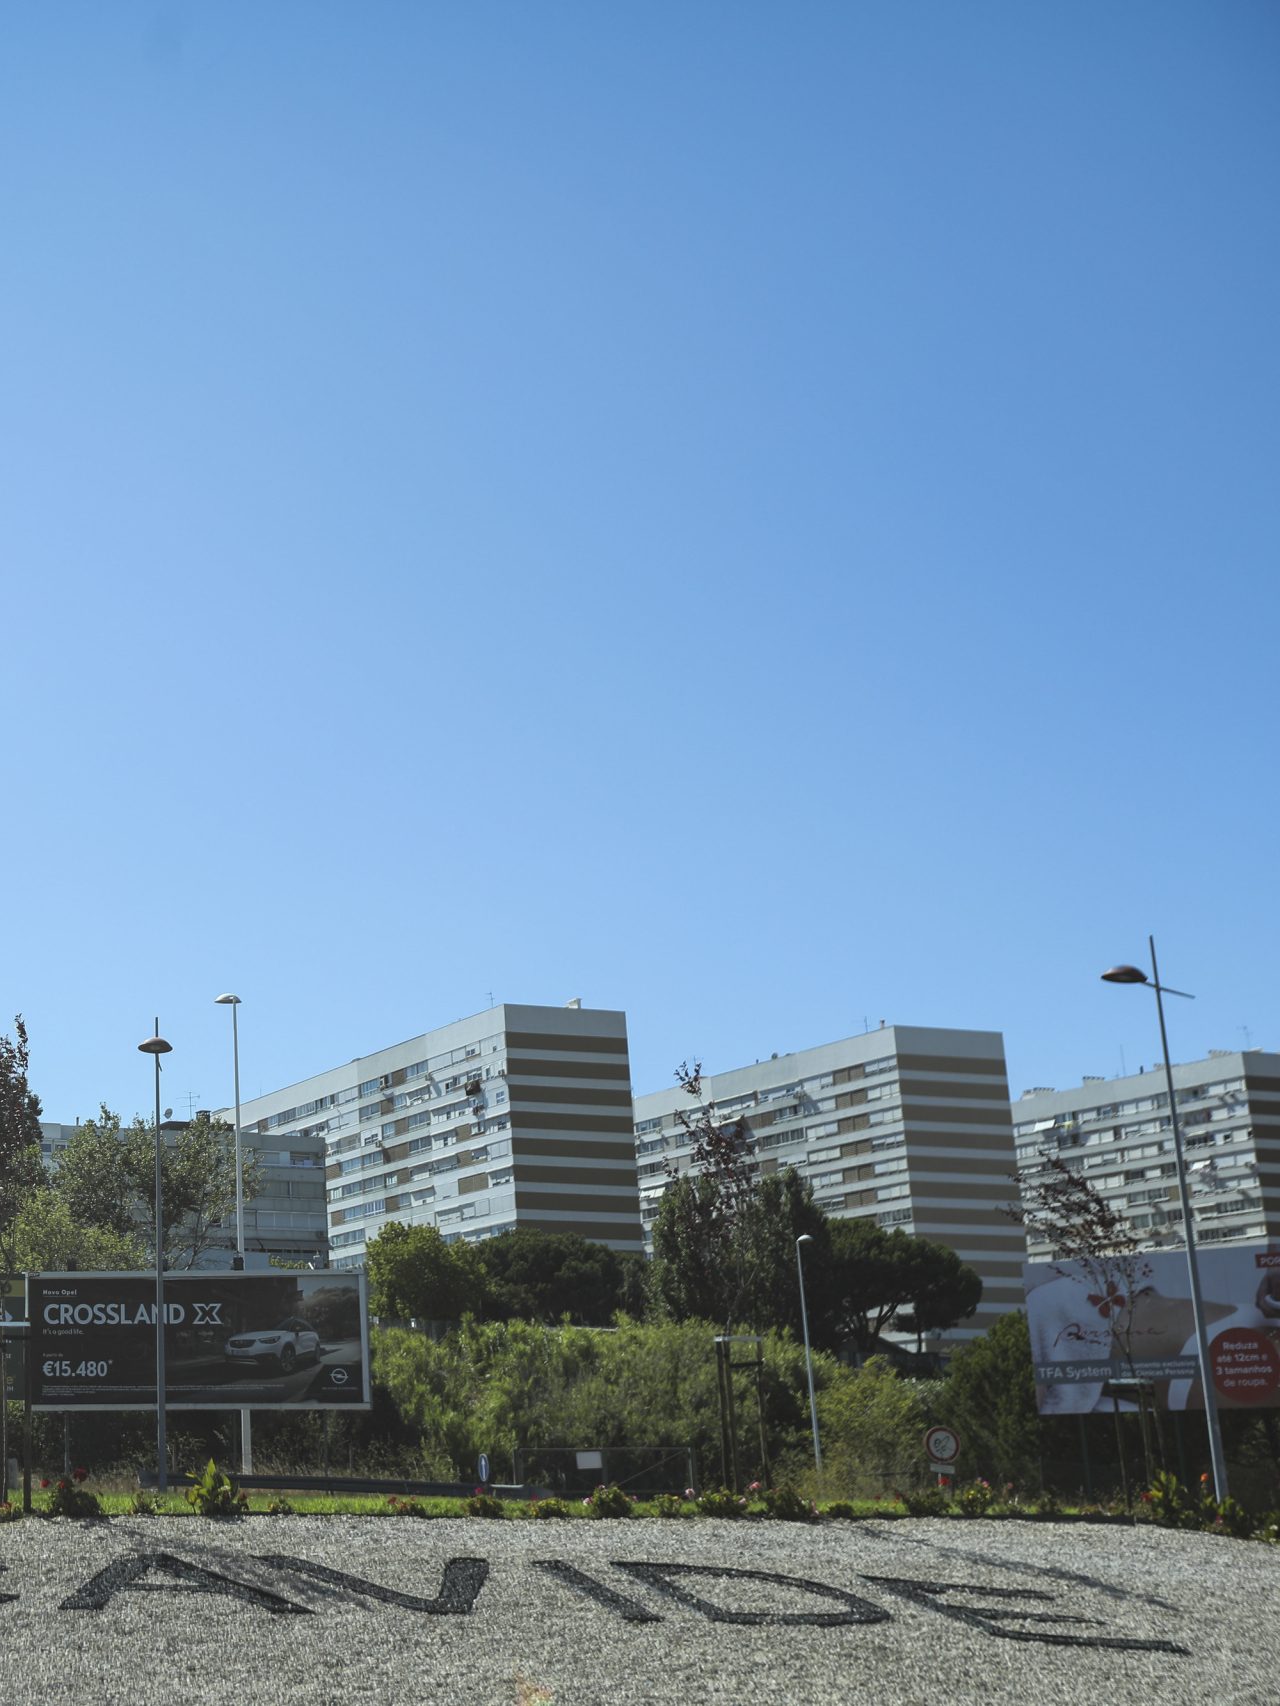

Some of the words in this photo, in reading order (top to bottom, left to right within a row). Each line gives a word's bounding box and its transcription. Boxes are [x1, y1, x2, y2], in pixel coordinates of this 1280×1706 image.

[43, 1303, 185, 1325] CROSSLAND
[192, 1303, 222, 1325] X
[1222, 1342, 1259, 1351] Reduza
[1234, 1353, 1260, 1362] 12cm
[1039, 1368, 1063, 1379] TFA
[1066, 1366, 1112, 1381] System
[1224, 1365, 1272, 1375] tamanhos
